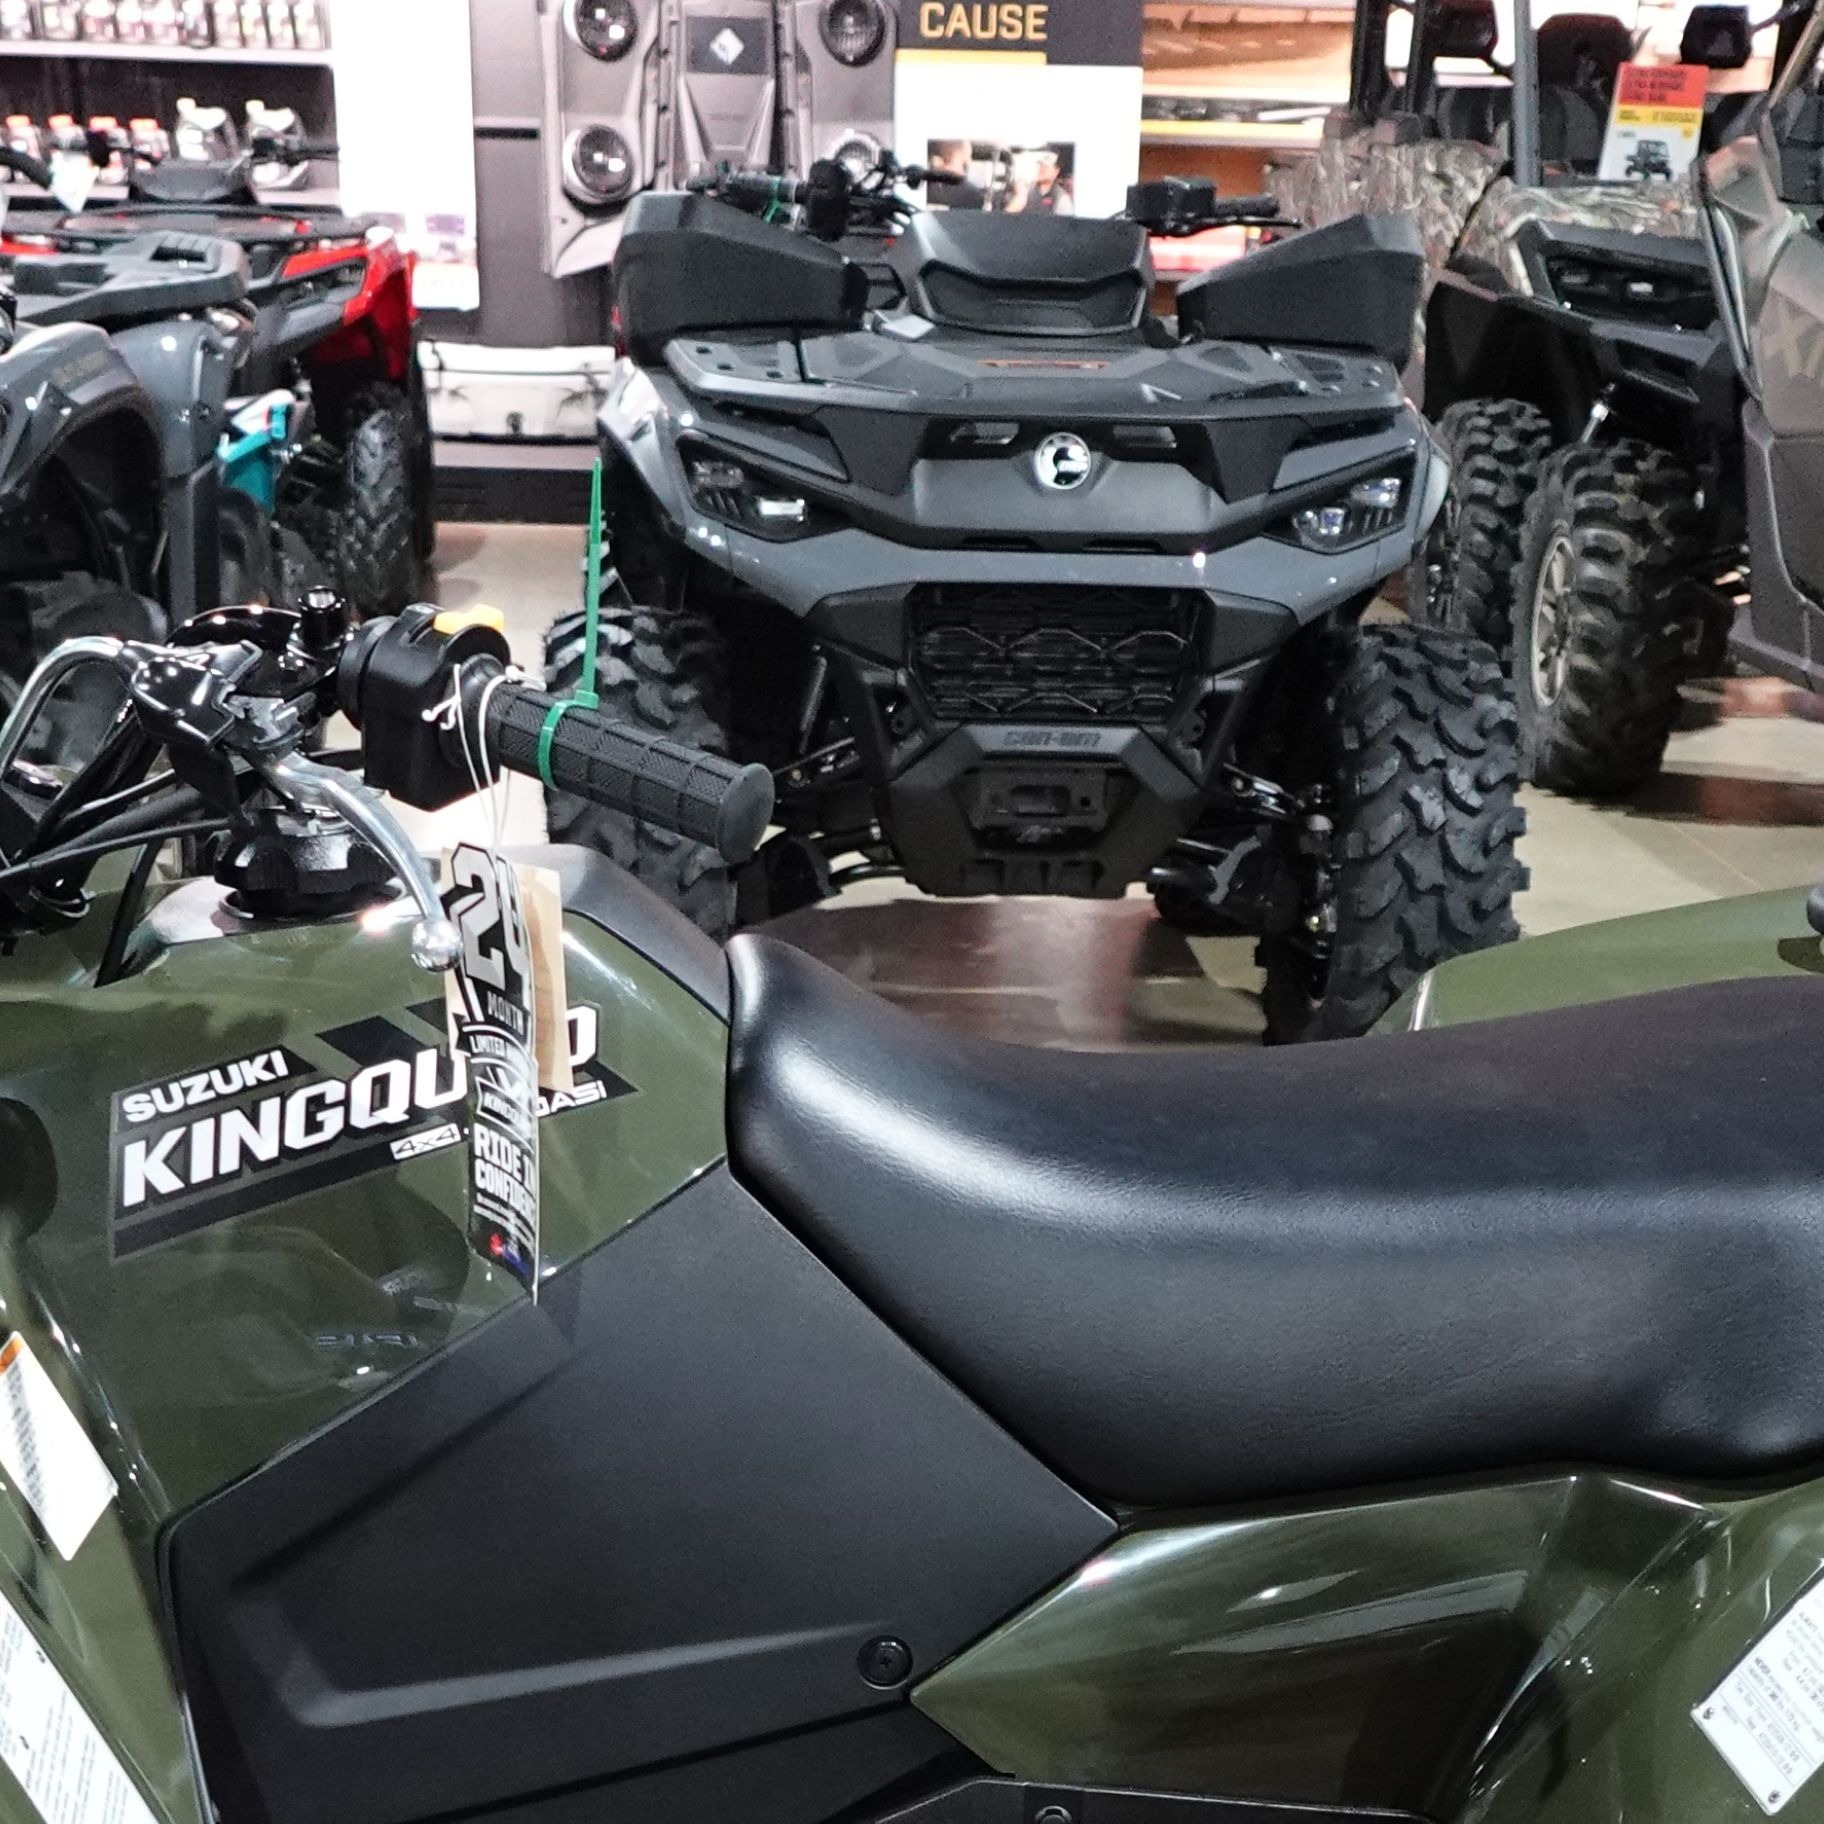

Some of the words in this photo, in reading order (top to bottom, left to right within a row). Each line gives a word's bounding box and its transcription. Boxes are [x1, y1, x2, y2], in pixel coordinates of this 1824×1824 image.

[920, 3, 1049, 41] CAUSE
[486, 990, 525, 1035] MONTH
[122, 1048, 288, 1123] SUZUKI
[122, 1005, 600, 1208] KINGQUD
[474, 1122, 522, 1177] RIDE
